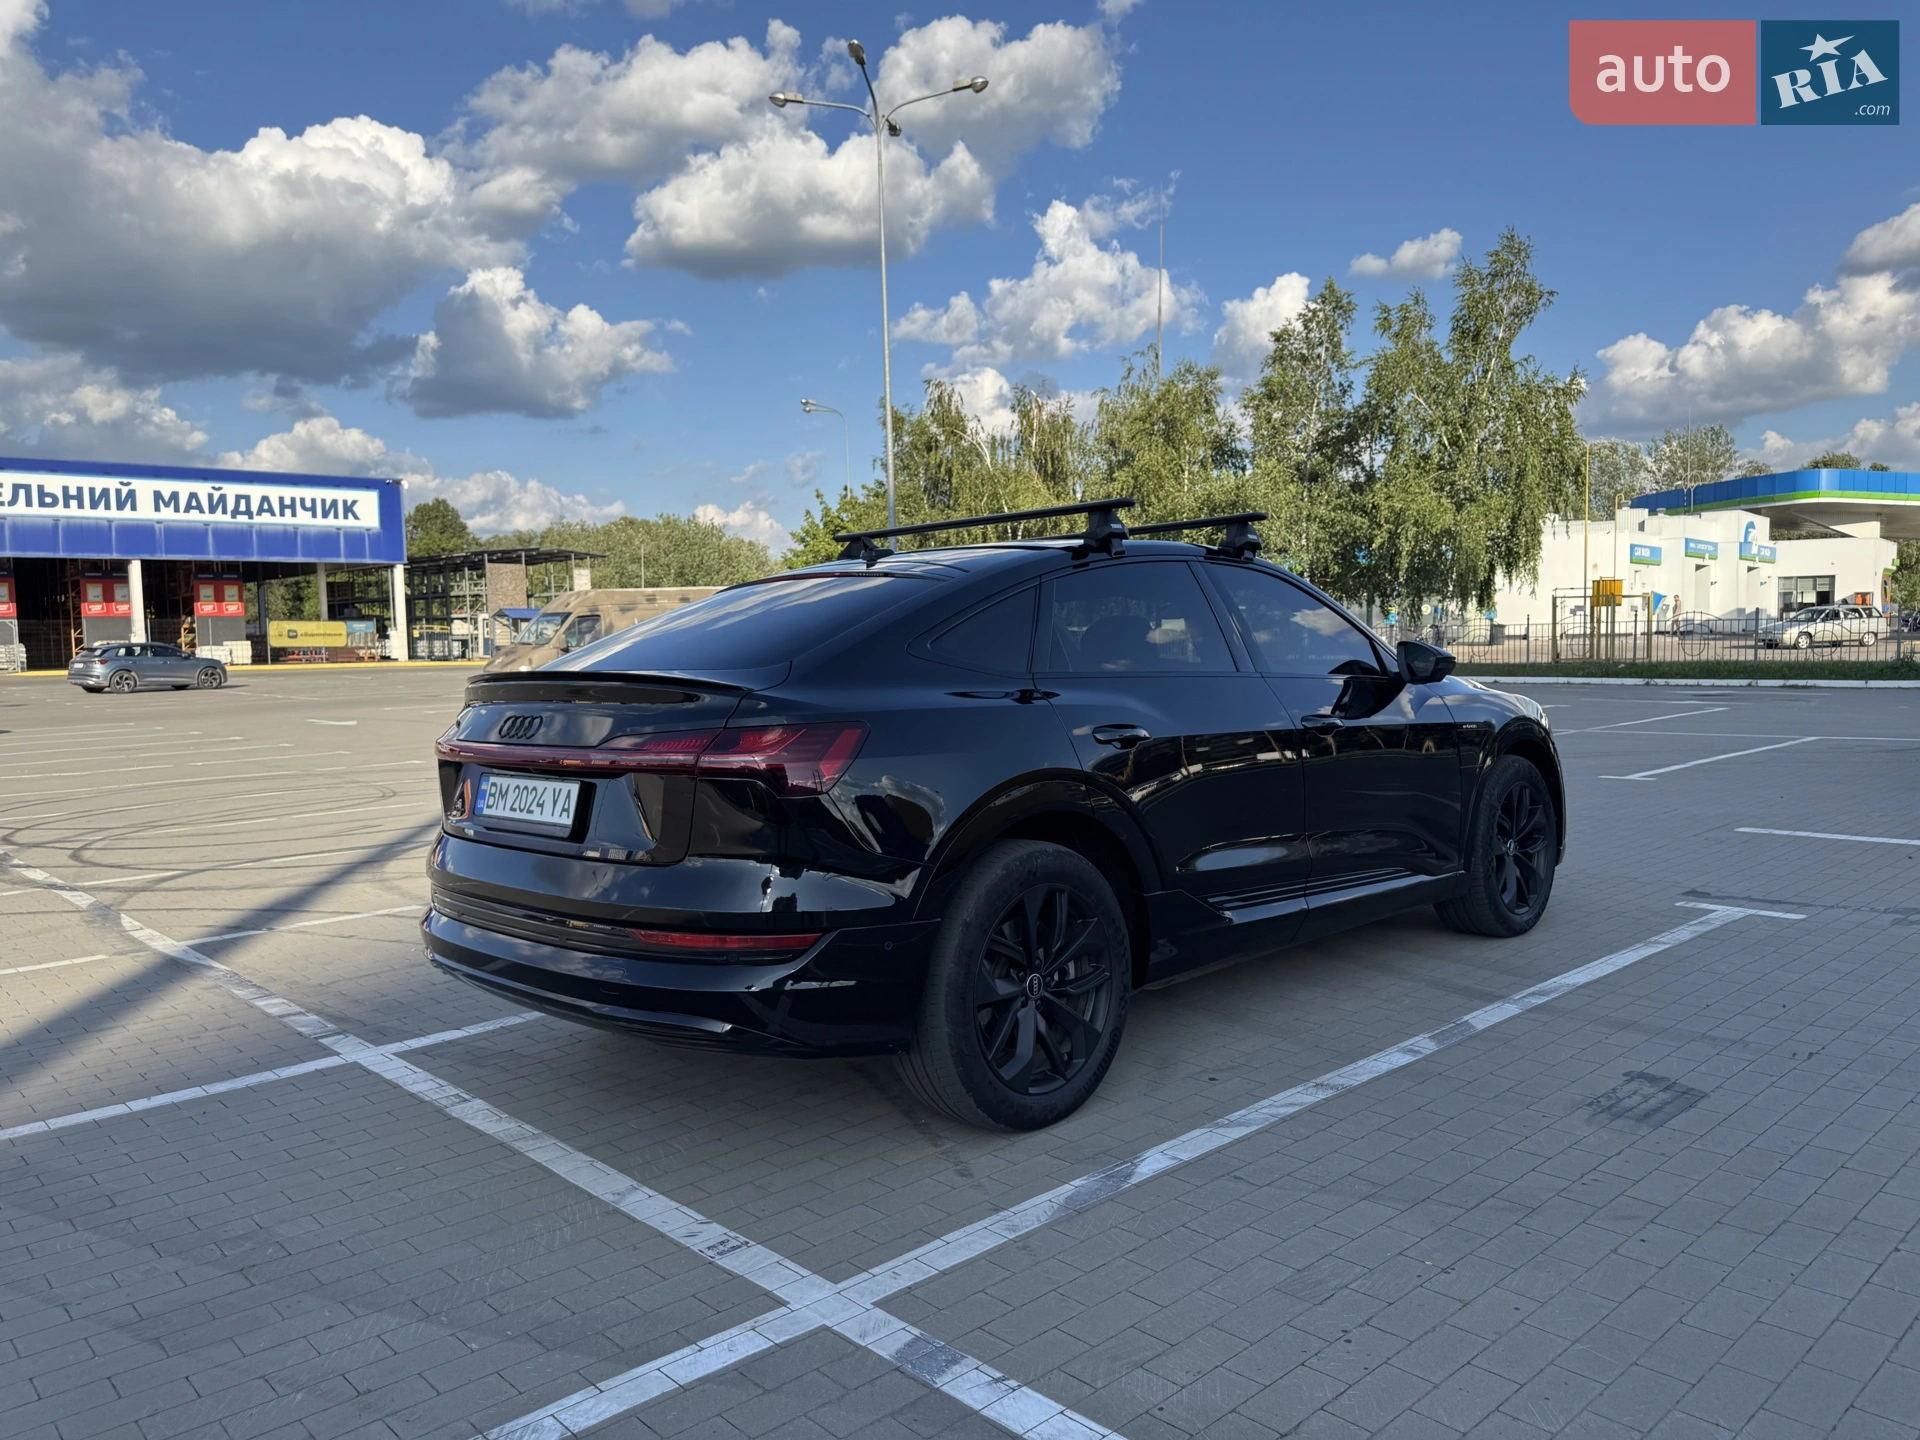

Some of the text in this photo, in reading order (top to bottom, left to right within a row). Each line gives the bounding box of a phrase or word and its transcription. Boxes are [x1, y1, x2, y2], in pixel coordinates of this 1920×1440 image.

[153, 485, 361, 521] МАЙДАНЧИК
[486, 782, 572, 818] BM 2024 YA
